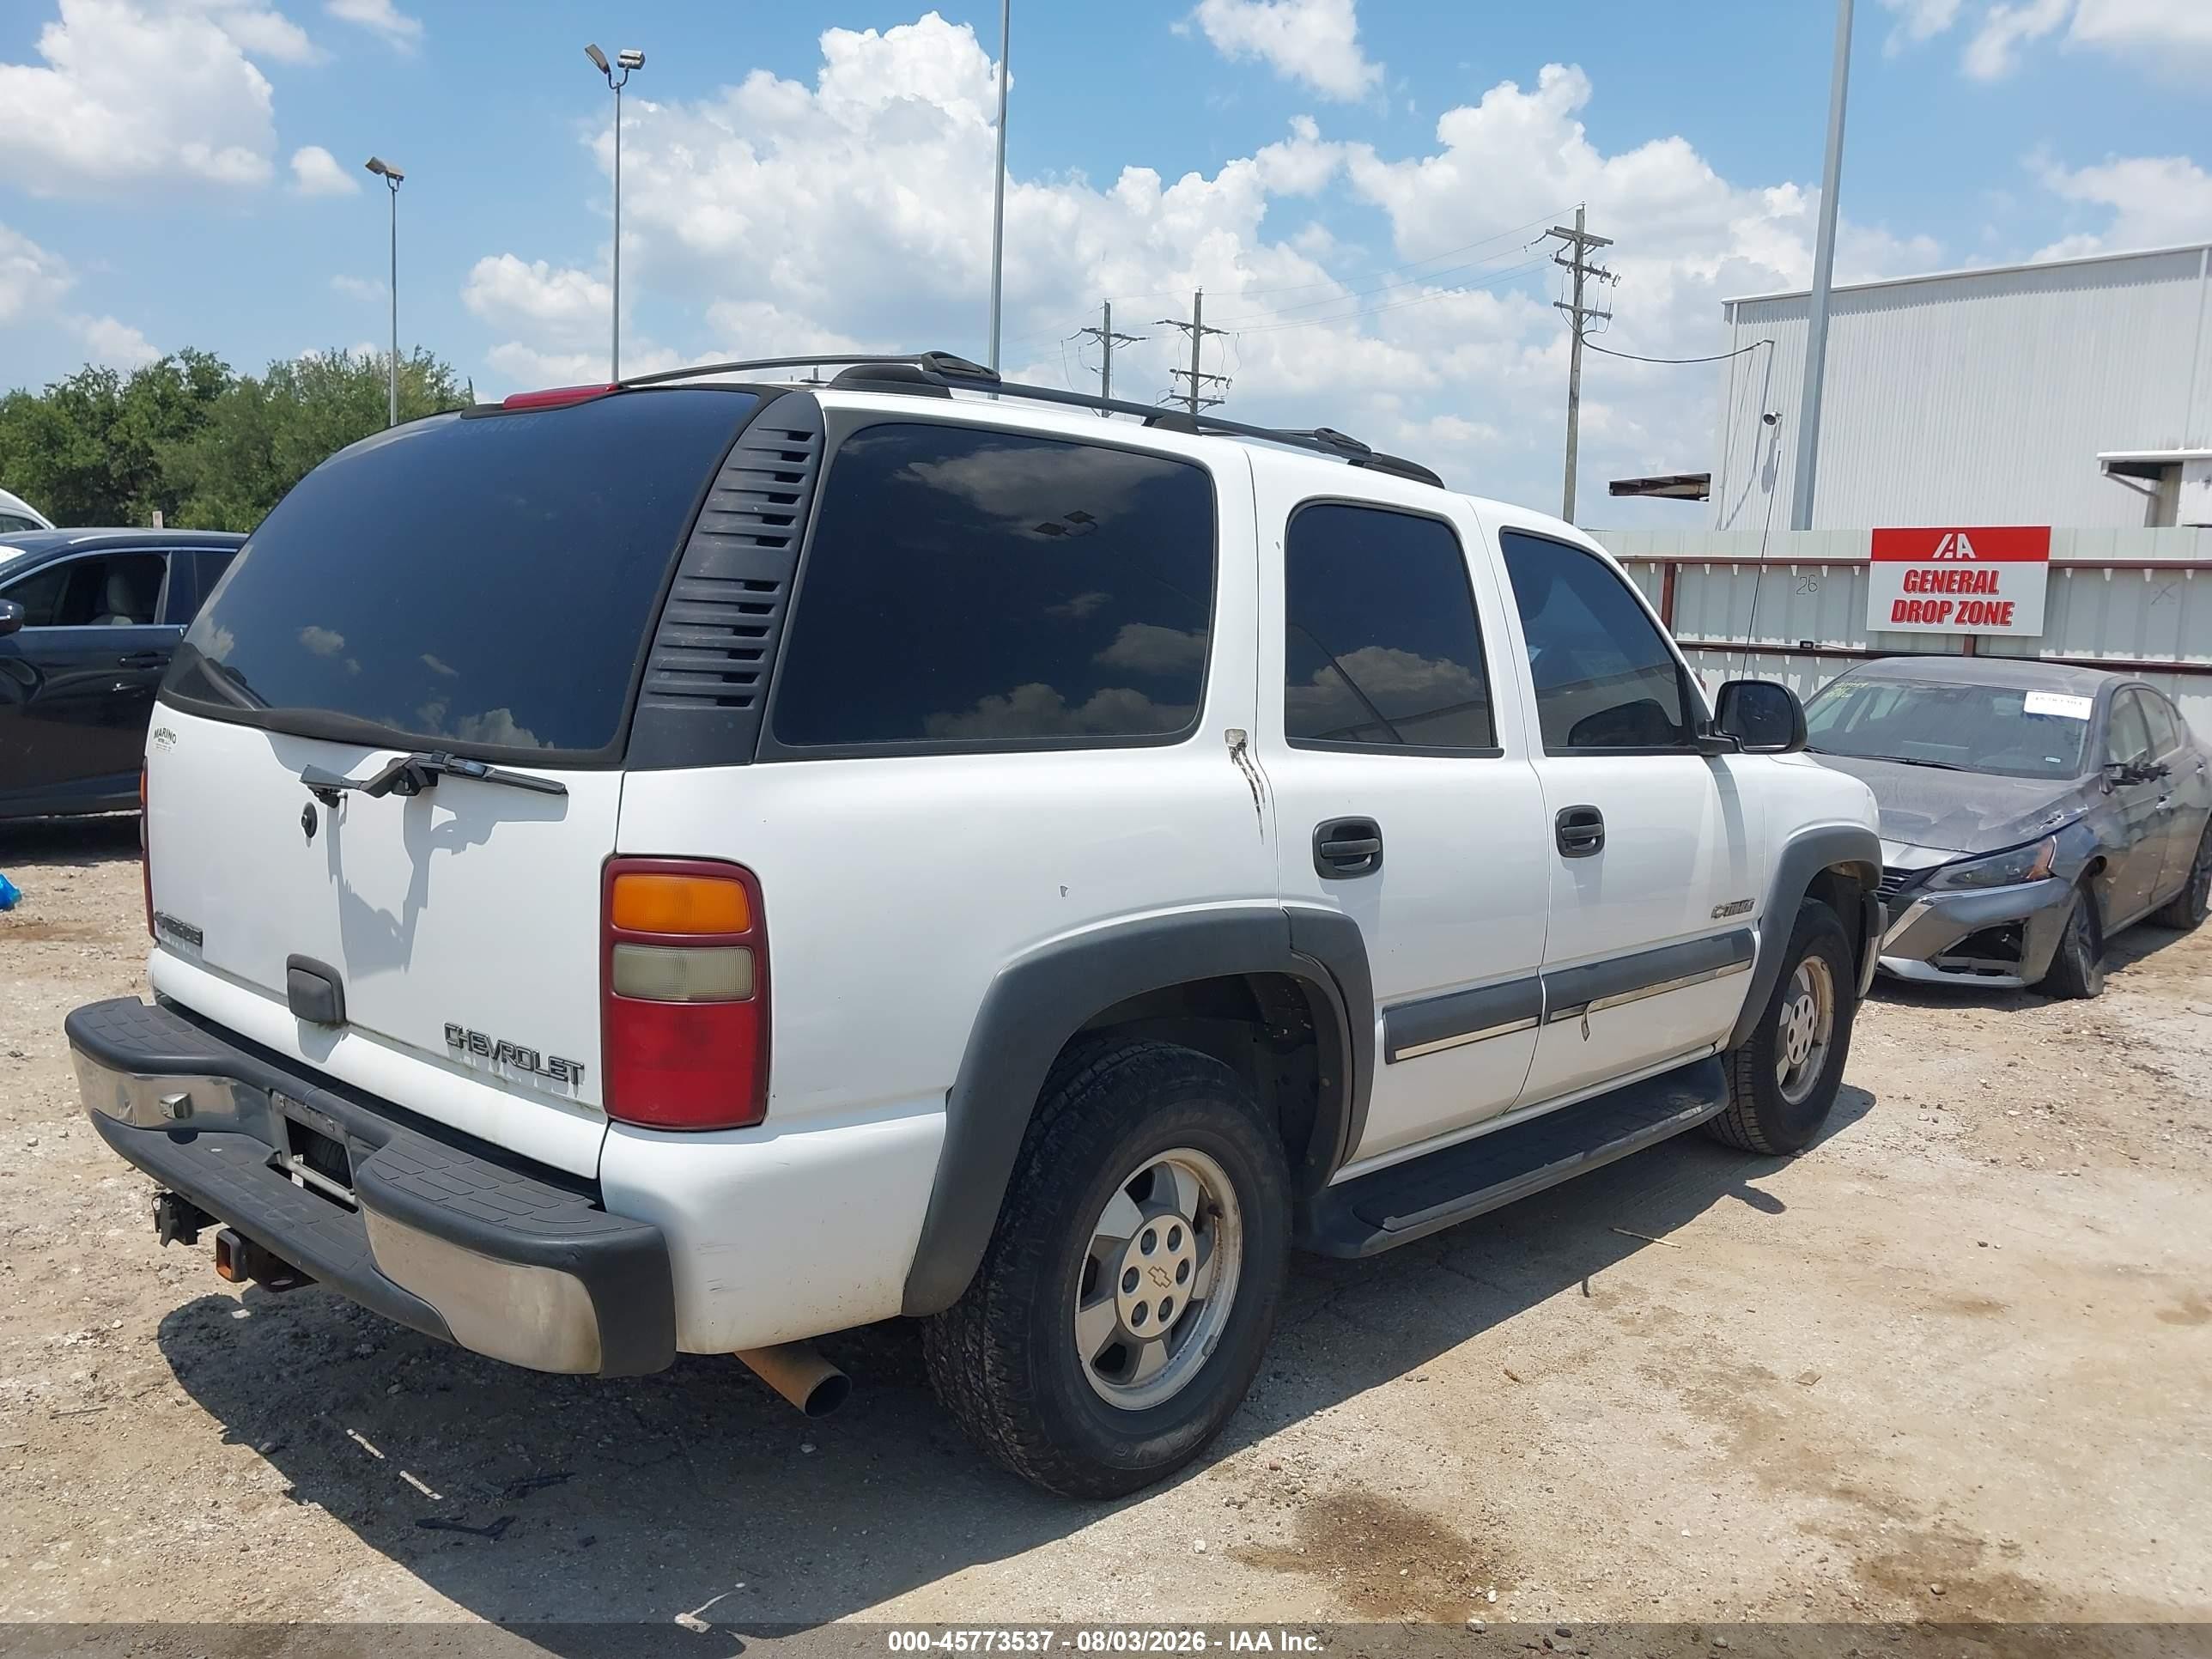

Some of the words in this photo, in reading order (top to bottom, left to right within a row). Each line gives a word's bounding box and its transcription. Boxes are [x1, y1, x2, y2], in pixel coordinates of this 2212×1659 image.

[1796, 574, 1818, 595] 26
[1902, 568, 2000, 595] GENERAL
[1890, 599, 1954, 624] DROP
[1954, 600, 2015, 627] ZONE
[153, 727, 177, 744] MARINO
[444, 1022, 585, 1086] CHEVROLET
